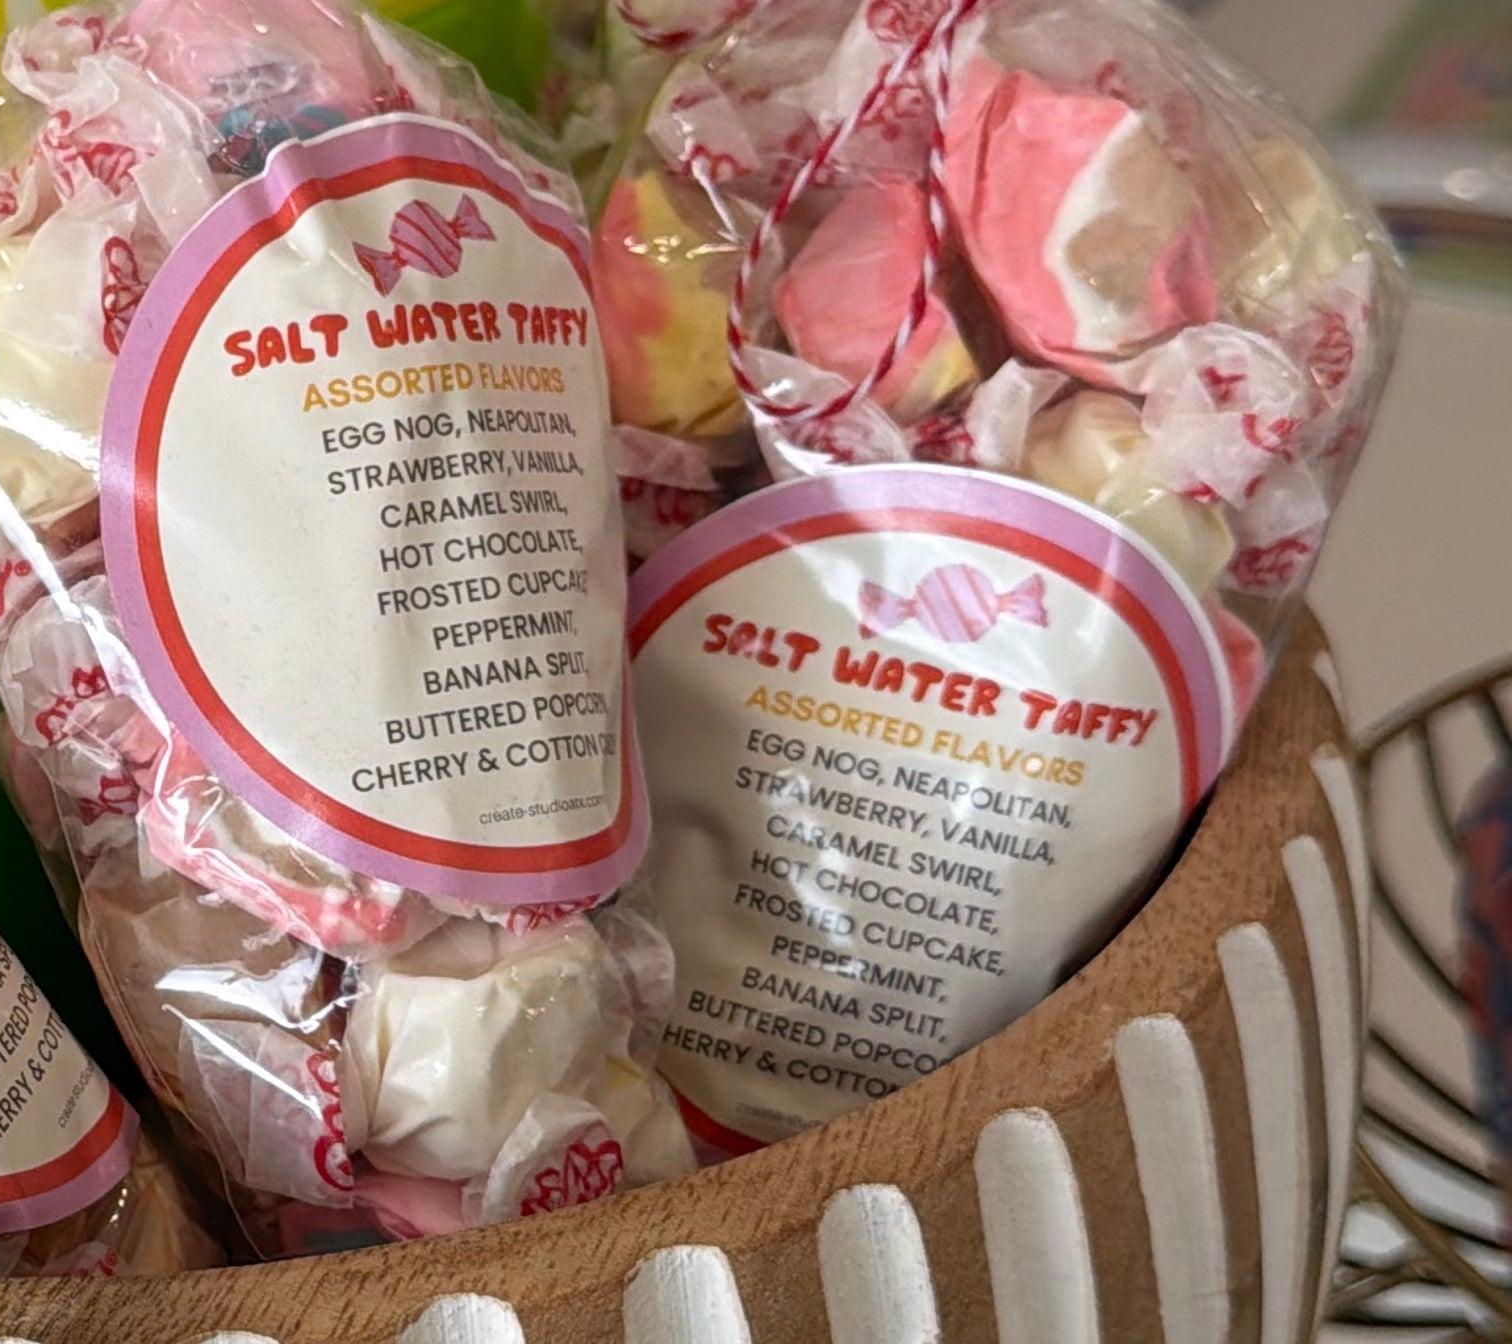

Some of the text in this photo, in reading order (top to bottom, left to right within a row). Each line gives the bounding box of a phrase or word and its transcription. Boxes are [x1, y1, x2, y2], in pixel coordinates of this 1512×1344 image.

[223, 301, 588, 378] SALT WATER TAFFY
[302, 362, 566, 413] ASSORTED FLAVORS
[321, 408, 577, 454] EGG NOG, NEAPOLITAN,
[327, 450, 584, 496] STRAWBERRY, VANILLA,
[380, 489, 569, 529] CARAMEL SWIRL,
[379, 528, 583, 573] HOT CHOCOLATE,
[377, 575, 502, 616] FROSTED
[432, 609, 579, 651] PEPPERMINT,
[422, 656, 542, 696] BANANA
[702, 612, 1158, 748] SALT WATER TAFFY
[385, 700, 527, 745] BUTTERED
[744, 685, 1087, 788] ASSORTED FLAVORS
[351, 751, 469, 793] CHERRY
[477, 747, 501, 773] &
[505, 733, 599, 768] COTTON
[745, 727, 1073, 830] EGG NOG, NEAPOLITAN,
[735, 766, 1057, 867] STRAWBERRY, VANILLA,
[766, 813, 1004, 897] CARAMEL SWIRL,
[750, 848, 1001, 937] HOT CHOCOLATE,
[734, 882, 1006, 977] FROSTED CUPCAKE,
[770, 934, 948, 1004] PEPPERMINT,
[687, 988, 954, 1077] BUTTERED POPCO
[741, 965, 948, 1044] BANANA SPLIT,
[27, 1058, 45, 1082] &
[37, 1010, 66, 1064] COTT
[661, 1022, 751, 1065] HERRY
[755, 1050, 777, 1074] &
